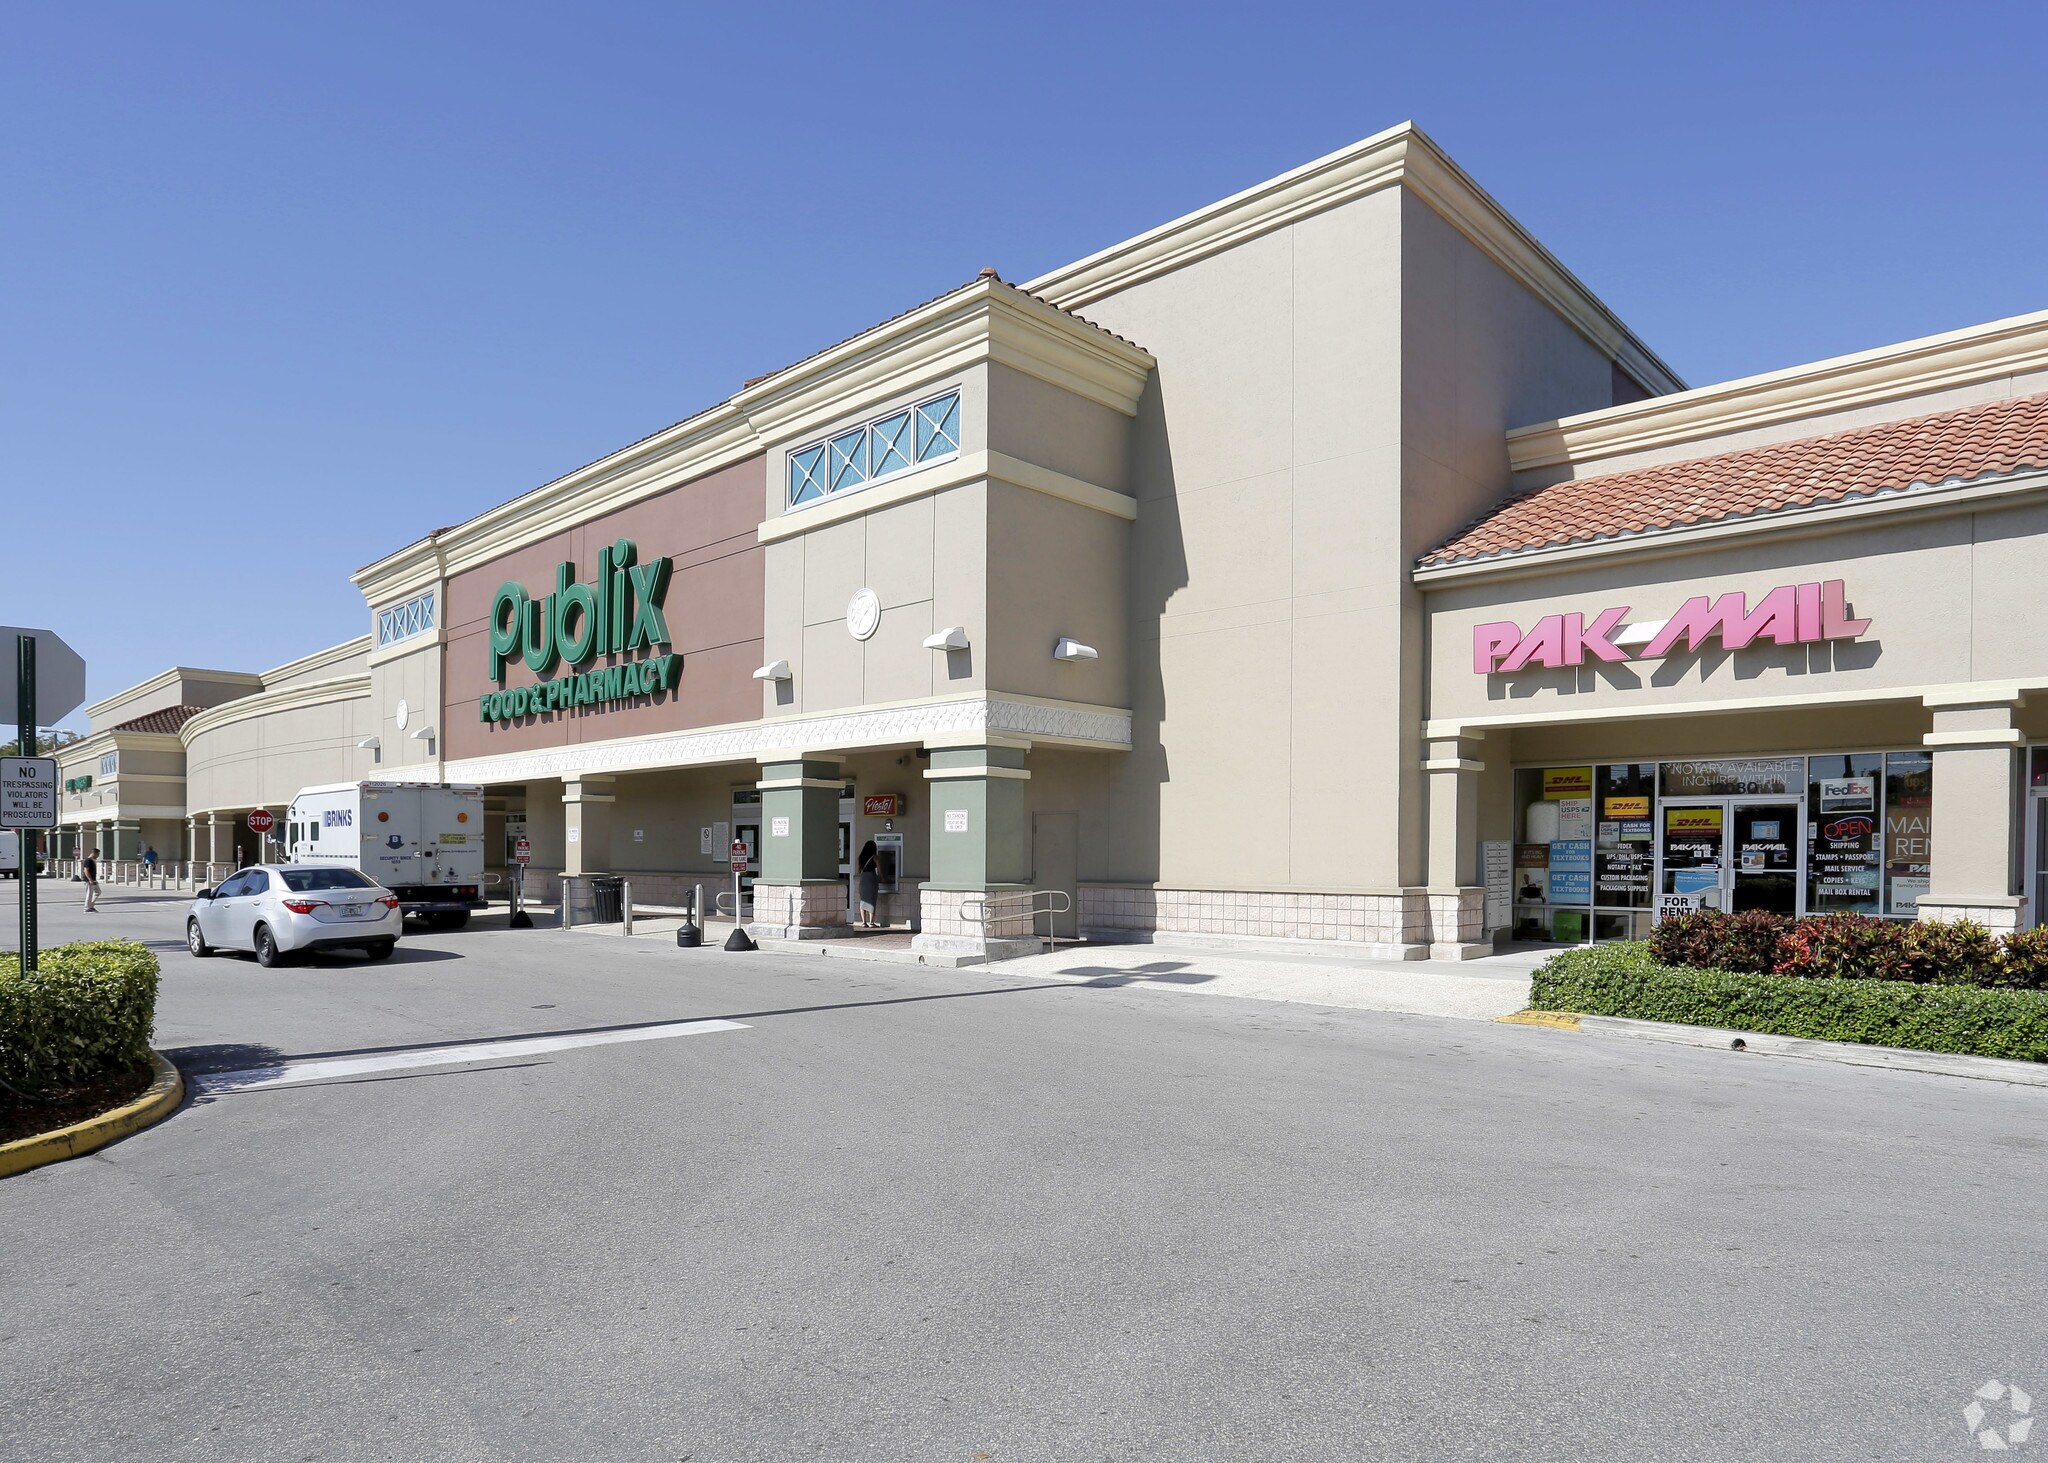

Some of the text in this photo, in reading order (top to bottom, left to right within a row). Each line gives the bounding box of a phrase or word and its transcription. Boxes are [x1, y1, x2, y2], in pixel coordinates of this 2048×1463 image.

[489, 538, 674, 683] Publix
[1474, 579, 1873, 674] PAK MAIL
[480, 653, 685, 723] FOOD & PHARMACY
[19, 767, 36, 778] NO
[1671, 761, 1802, 775] NOTARY AVAILABLE,
[3, 780, 53, 789] TRESPASSING
[1551, 775, 1584, 784] DHL
[1682, 775, 1737, 787] INQUIRE
[1824, 783, 1868, 796] FedEx
[7, 791, 48, 799] VIOLATORS
[12, 801, 43, 809] WILL BE
[865, 798, 893, 814] Presto!
[1611, 802, 1642, 810] DHL
[3, 811, 52, 819] PROSECUTED
[326, 809, 352, 826] BRINKS
[250, 816, 272, 826] STOP
[1676, 818, 1713, 827] DHL
[1824, 821, 1872, 837] OPEN
[1664, 897, 1688, 906] FOR
[1660, 907, 1692, 916] RENT
